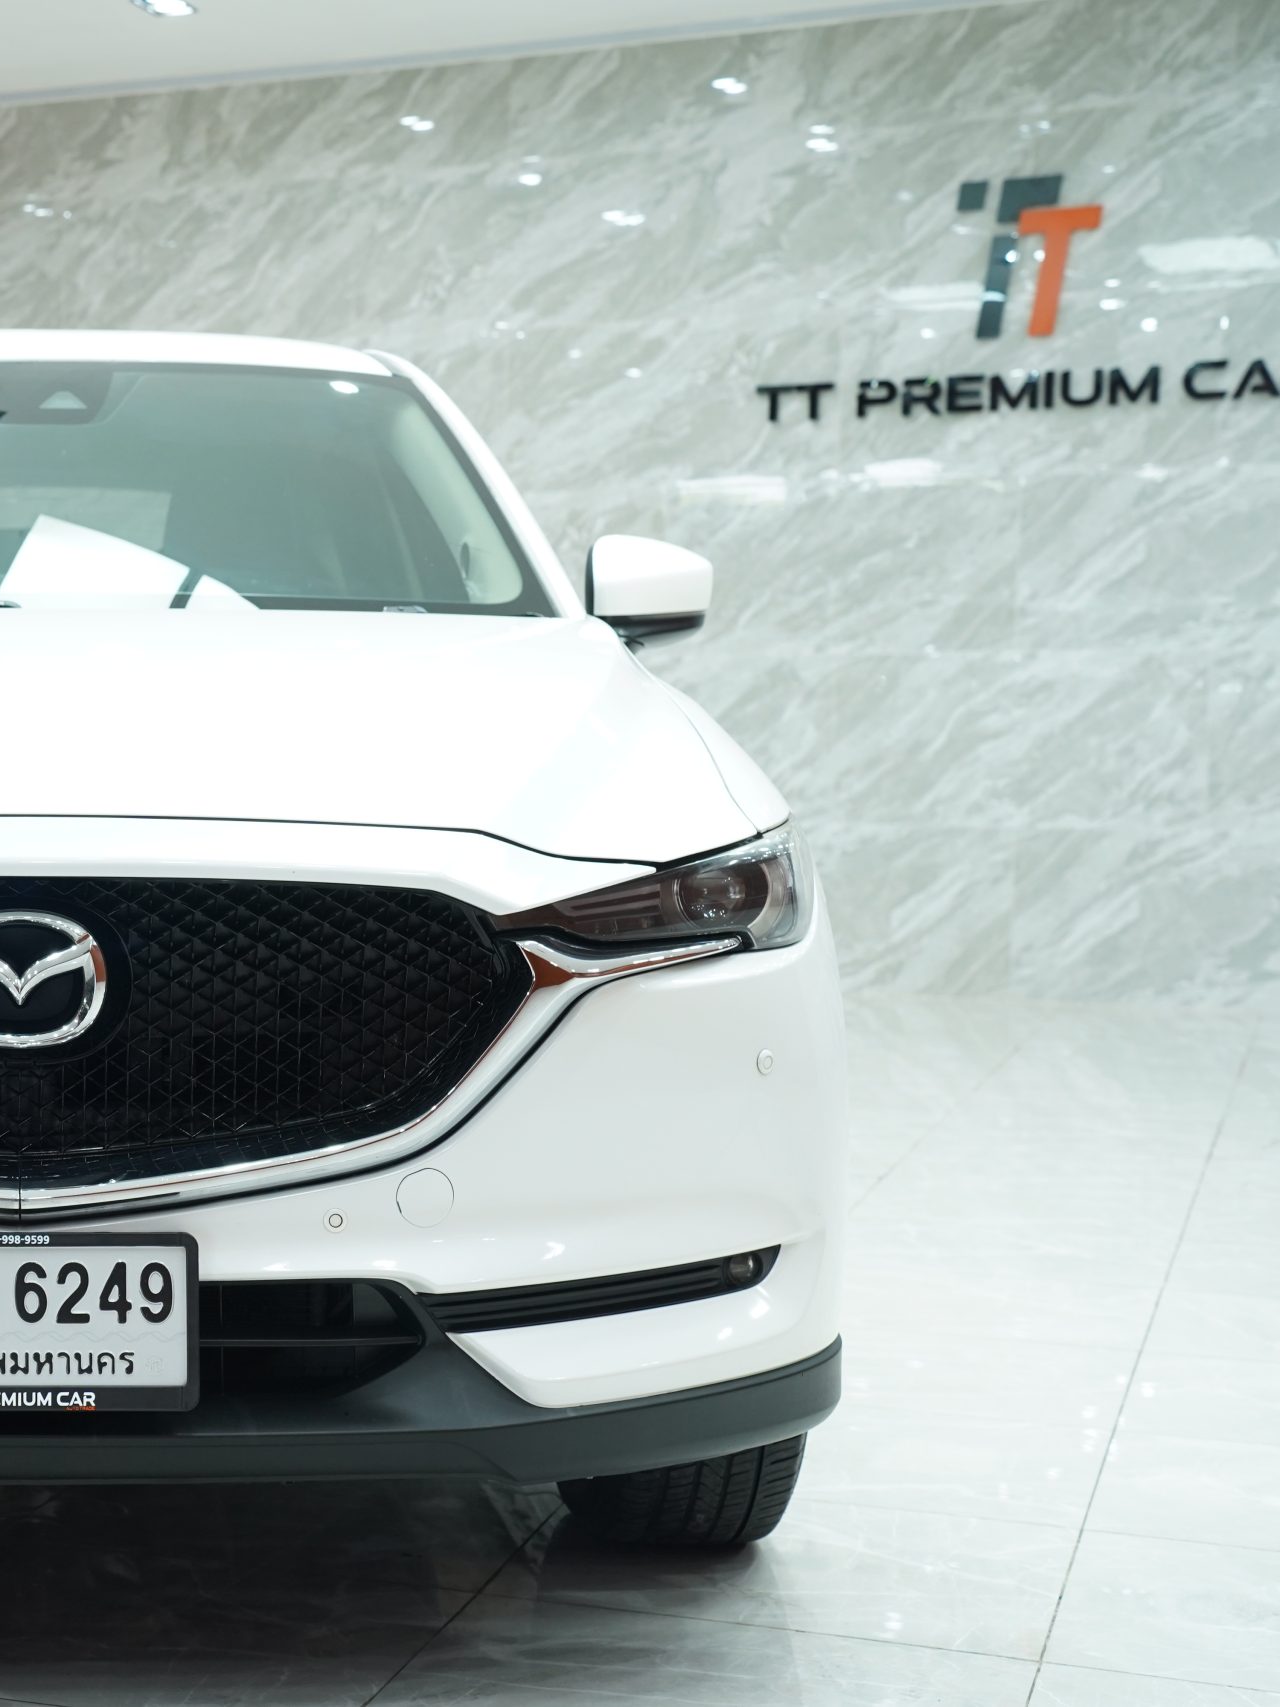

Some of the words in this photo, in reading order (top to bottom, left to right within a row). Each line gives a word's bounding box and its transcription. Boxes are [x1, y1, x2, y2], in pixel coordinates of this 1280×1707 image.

[756, 383, 835, 423] TT
[857, 366, 1162, 418] PREMIUM
[1183, 359, 1280, 401] CA
[15, 1261, 174, 1324] 6249
[56, 1391, 96, 1407] CAR
